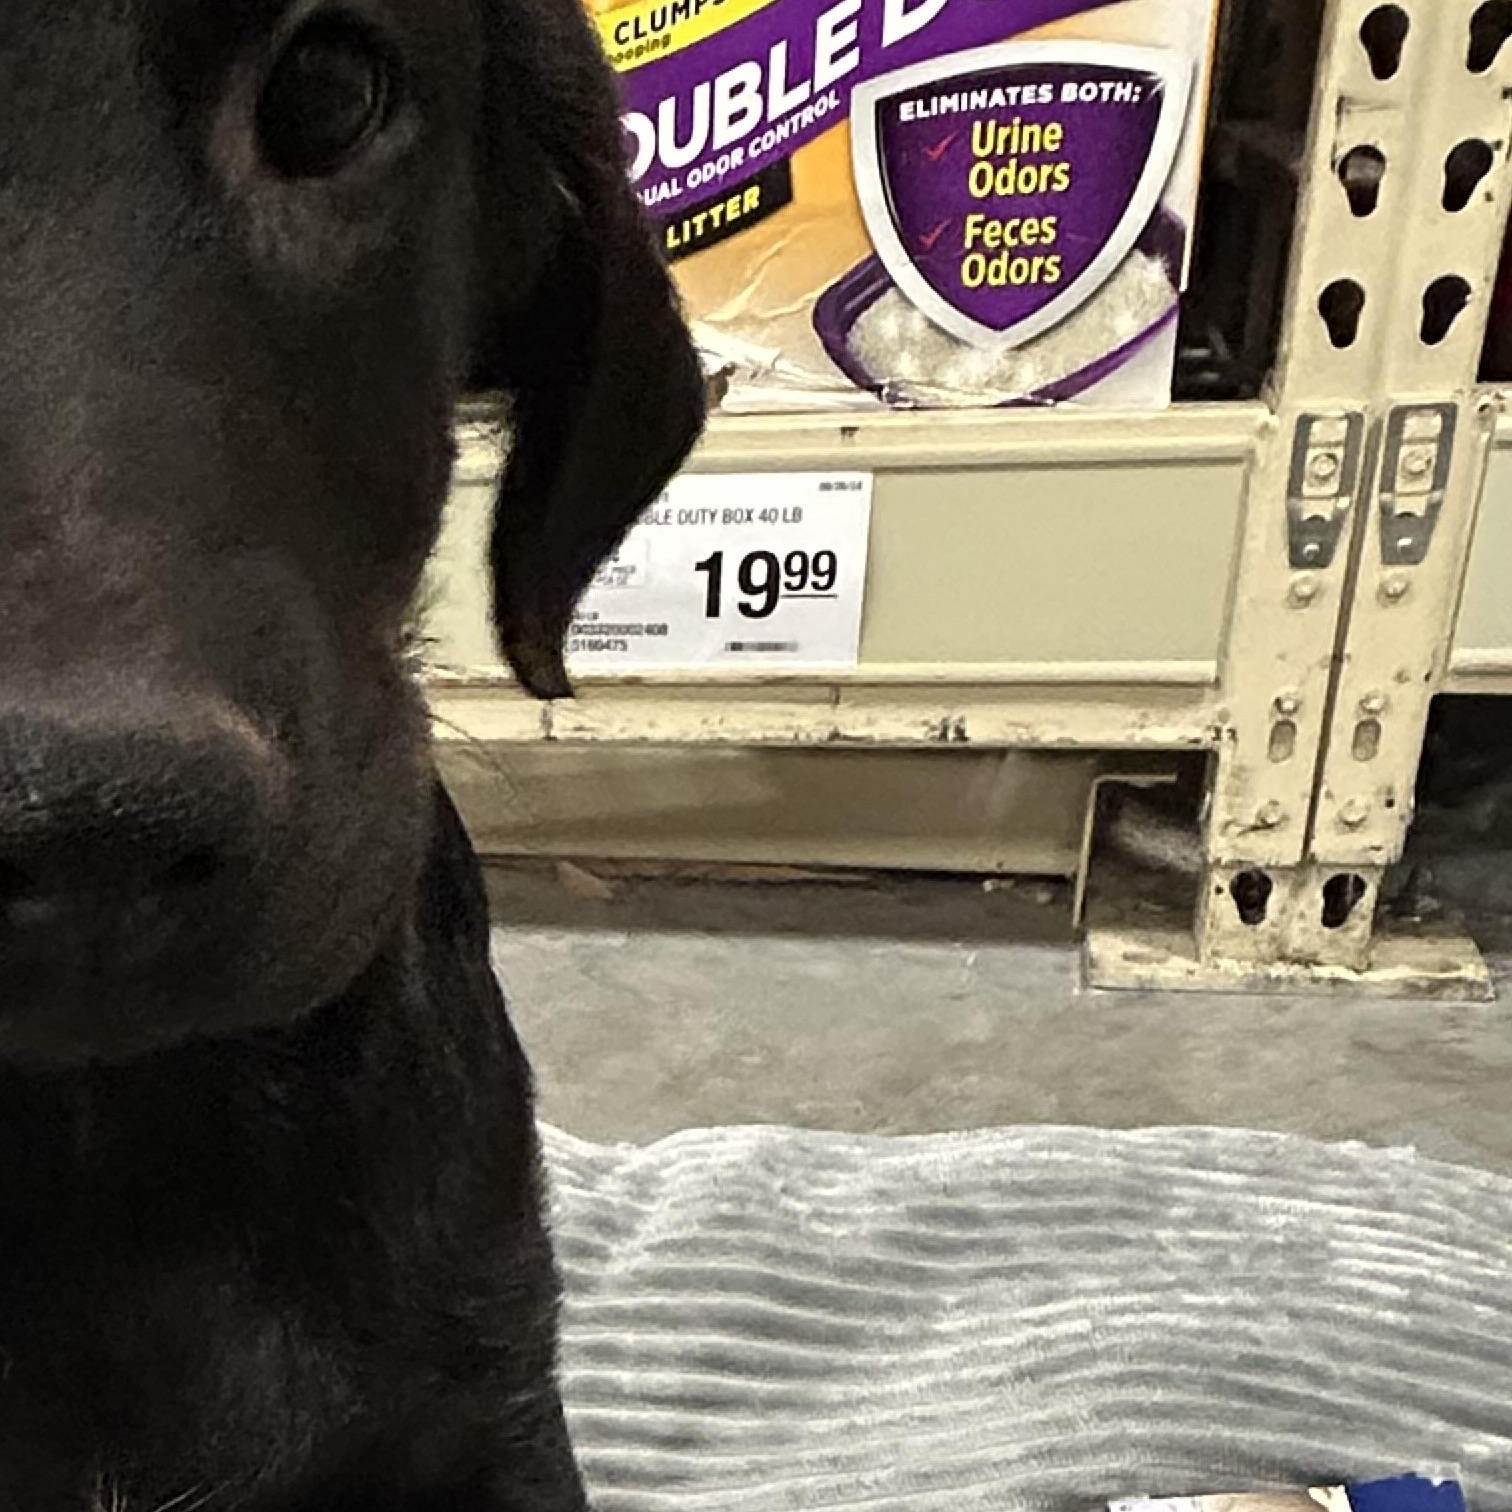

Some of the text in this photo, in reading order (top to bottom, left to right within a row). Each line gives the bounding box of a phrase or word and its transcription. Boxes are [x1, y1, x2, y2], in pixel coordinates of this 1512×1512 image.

[614, 0, 724, 45] CLUMP
[619, 0, 859, 183] OUBLE
[899, 81, 1142, 122] ELIMINATES BOTH:
[687, 147, 743, 189] ODOR
[748, 89, 840, 158] CONTROL
[972, 116, 1064, 157] Urine
[968, 158, 1070, 198] Odors
[666, 185, 760, 249] LITTER
[964, 214, 1058, 250] Feces
[961, 251, 1062, 288] Odors
[677, 508, 718, 525] DUTY
[722, 508, 753, 524] BOX
[758, 507, 779, 524] 40
[783, 507, 803, 523] LB
